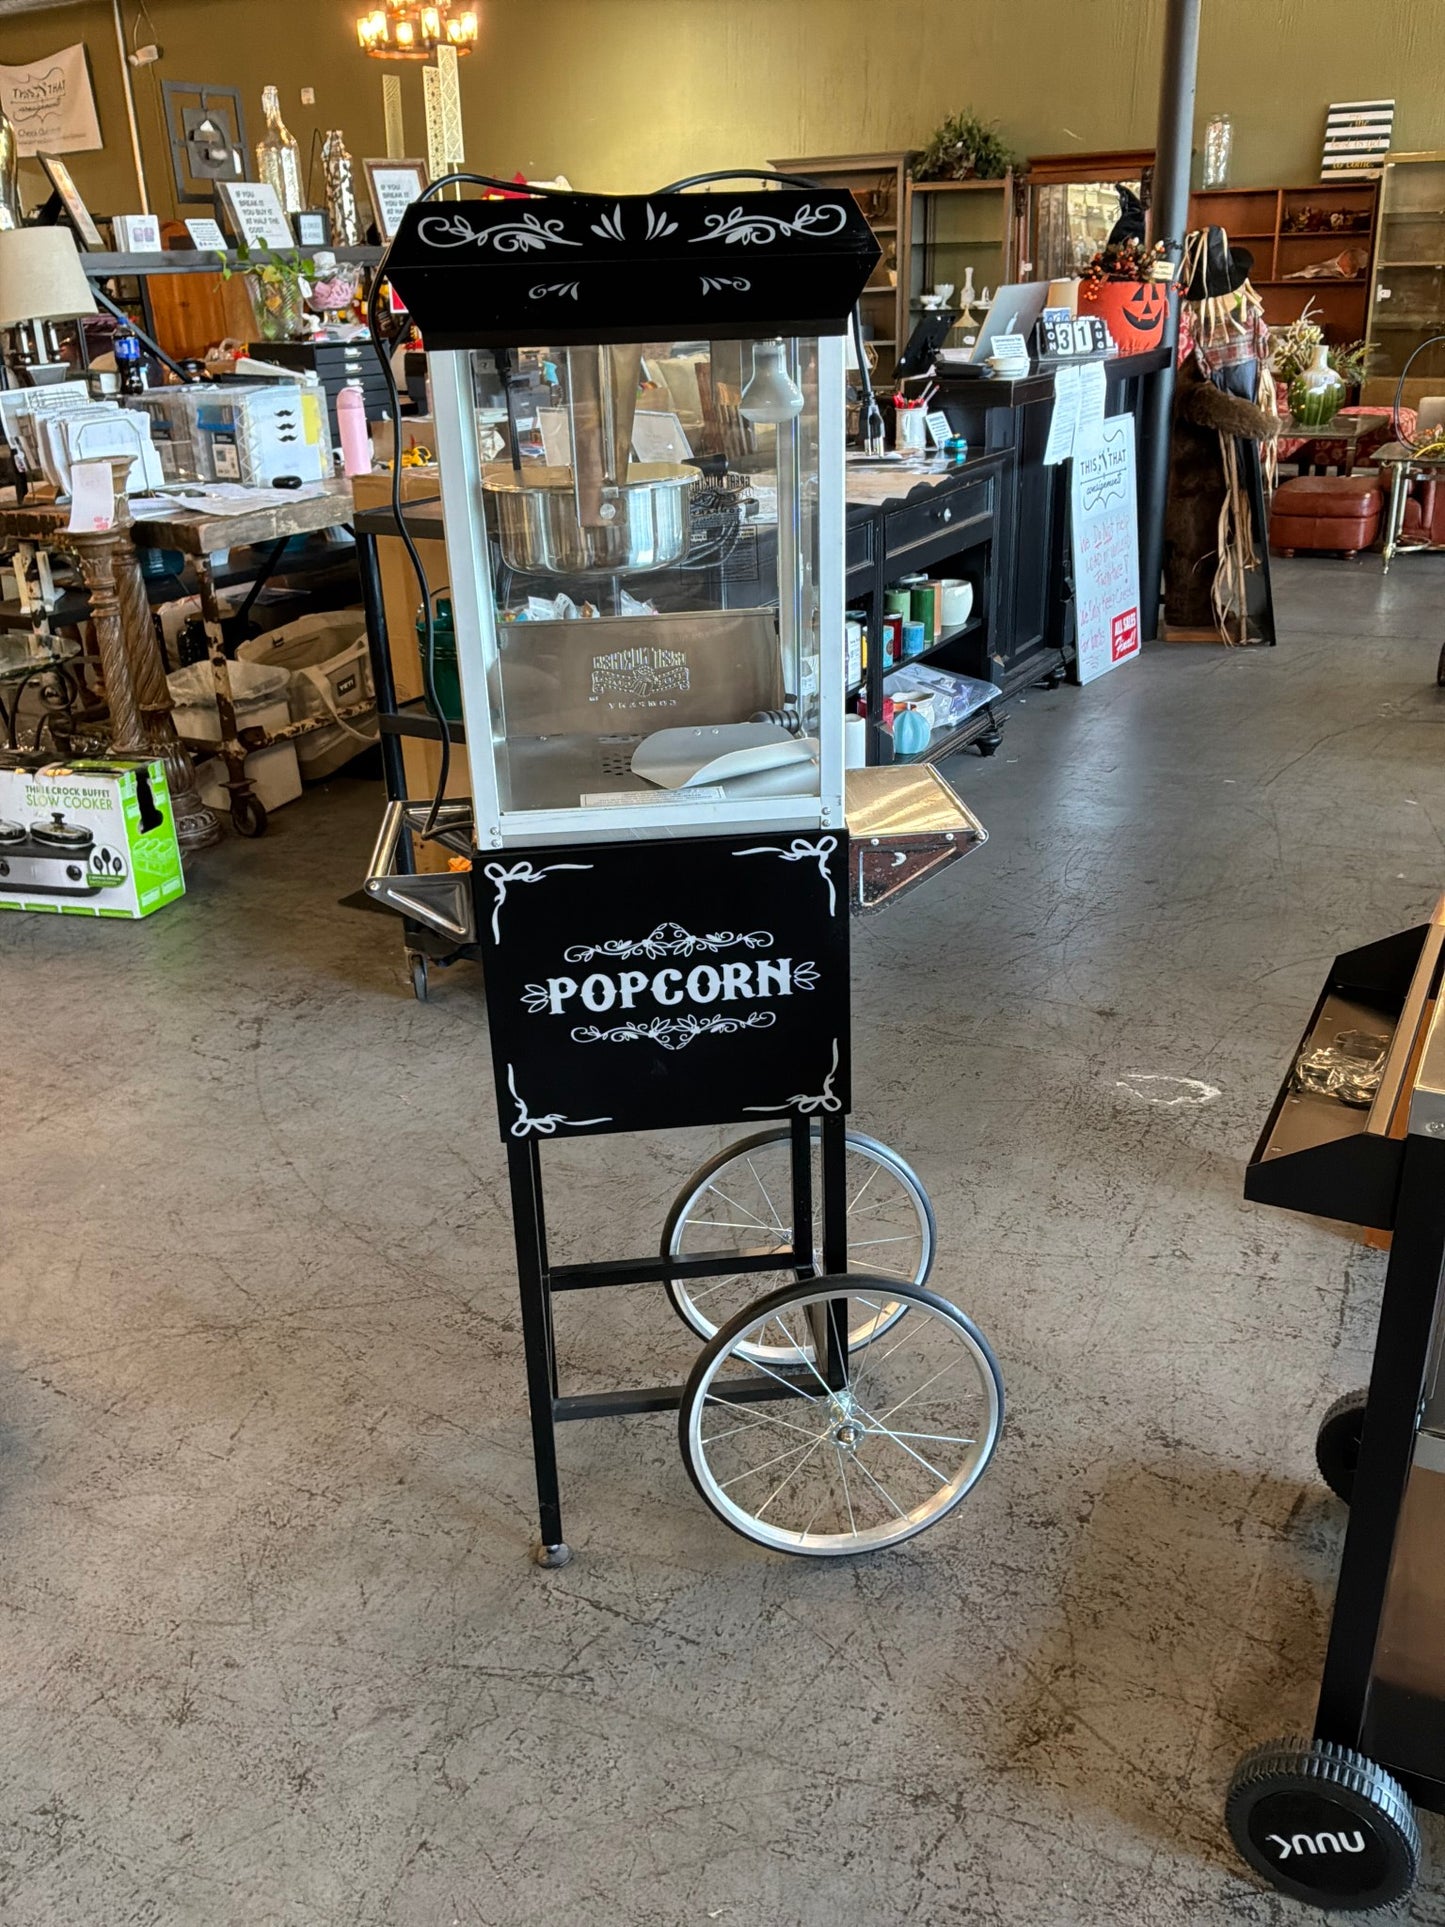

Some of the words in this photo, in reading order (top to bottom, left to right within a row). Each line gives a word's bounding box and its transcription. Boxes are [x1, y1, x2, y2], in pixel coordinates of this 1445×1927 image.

[1045, 322, 1057, 351] MON
[1080, 458, 1097, 476] THIS
[1108, 449, 1126, 467] THAT
[339, 680, 354, 691] YETI
[26, 794, 60, 806] SLOW
[63, 796, 113, 810] COOKER
[51, 786, 80, 797] CROCK
[82, 788, 110, 797] BUFFET
[546, 957, 794, 1015] POPCORN
